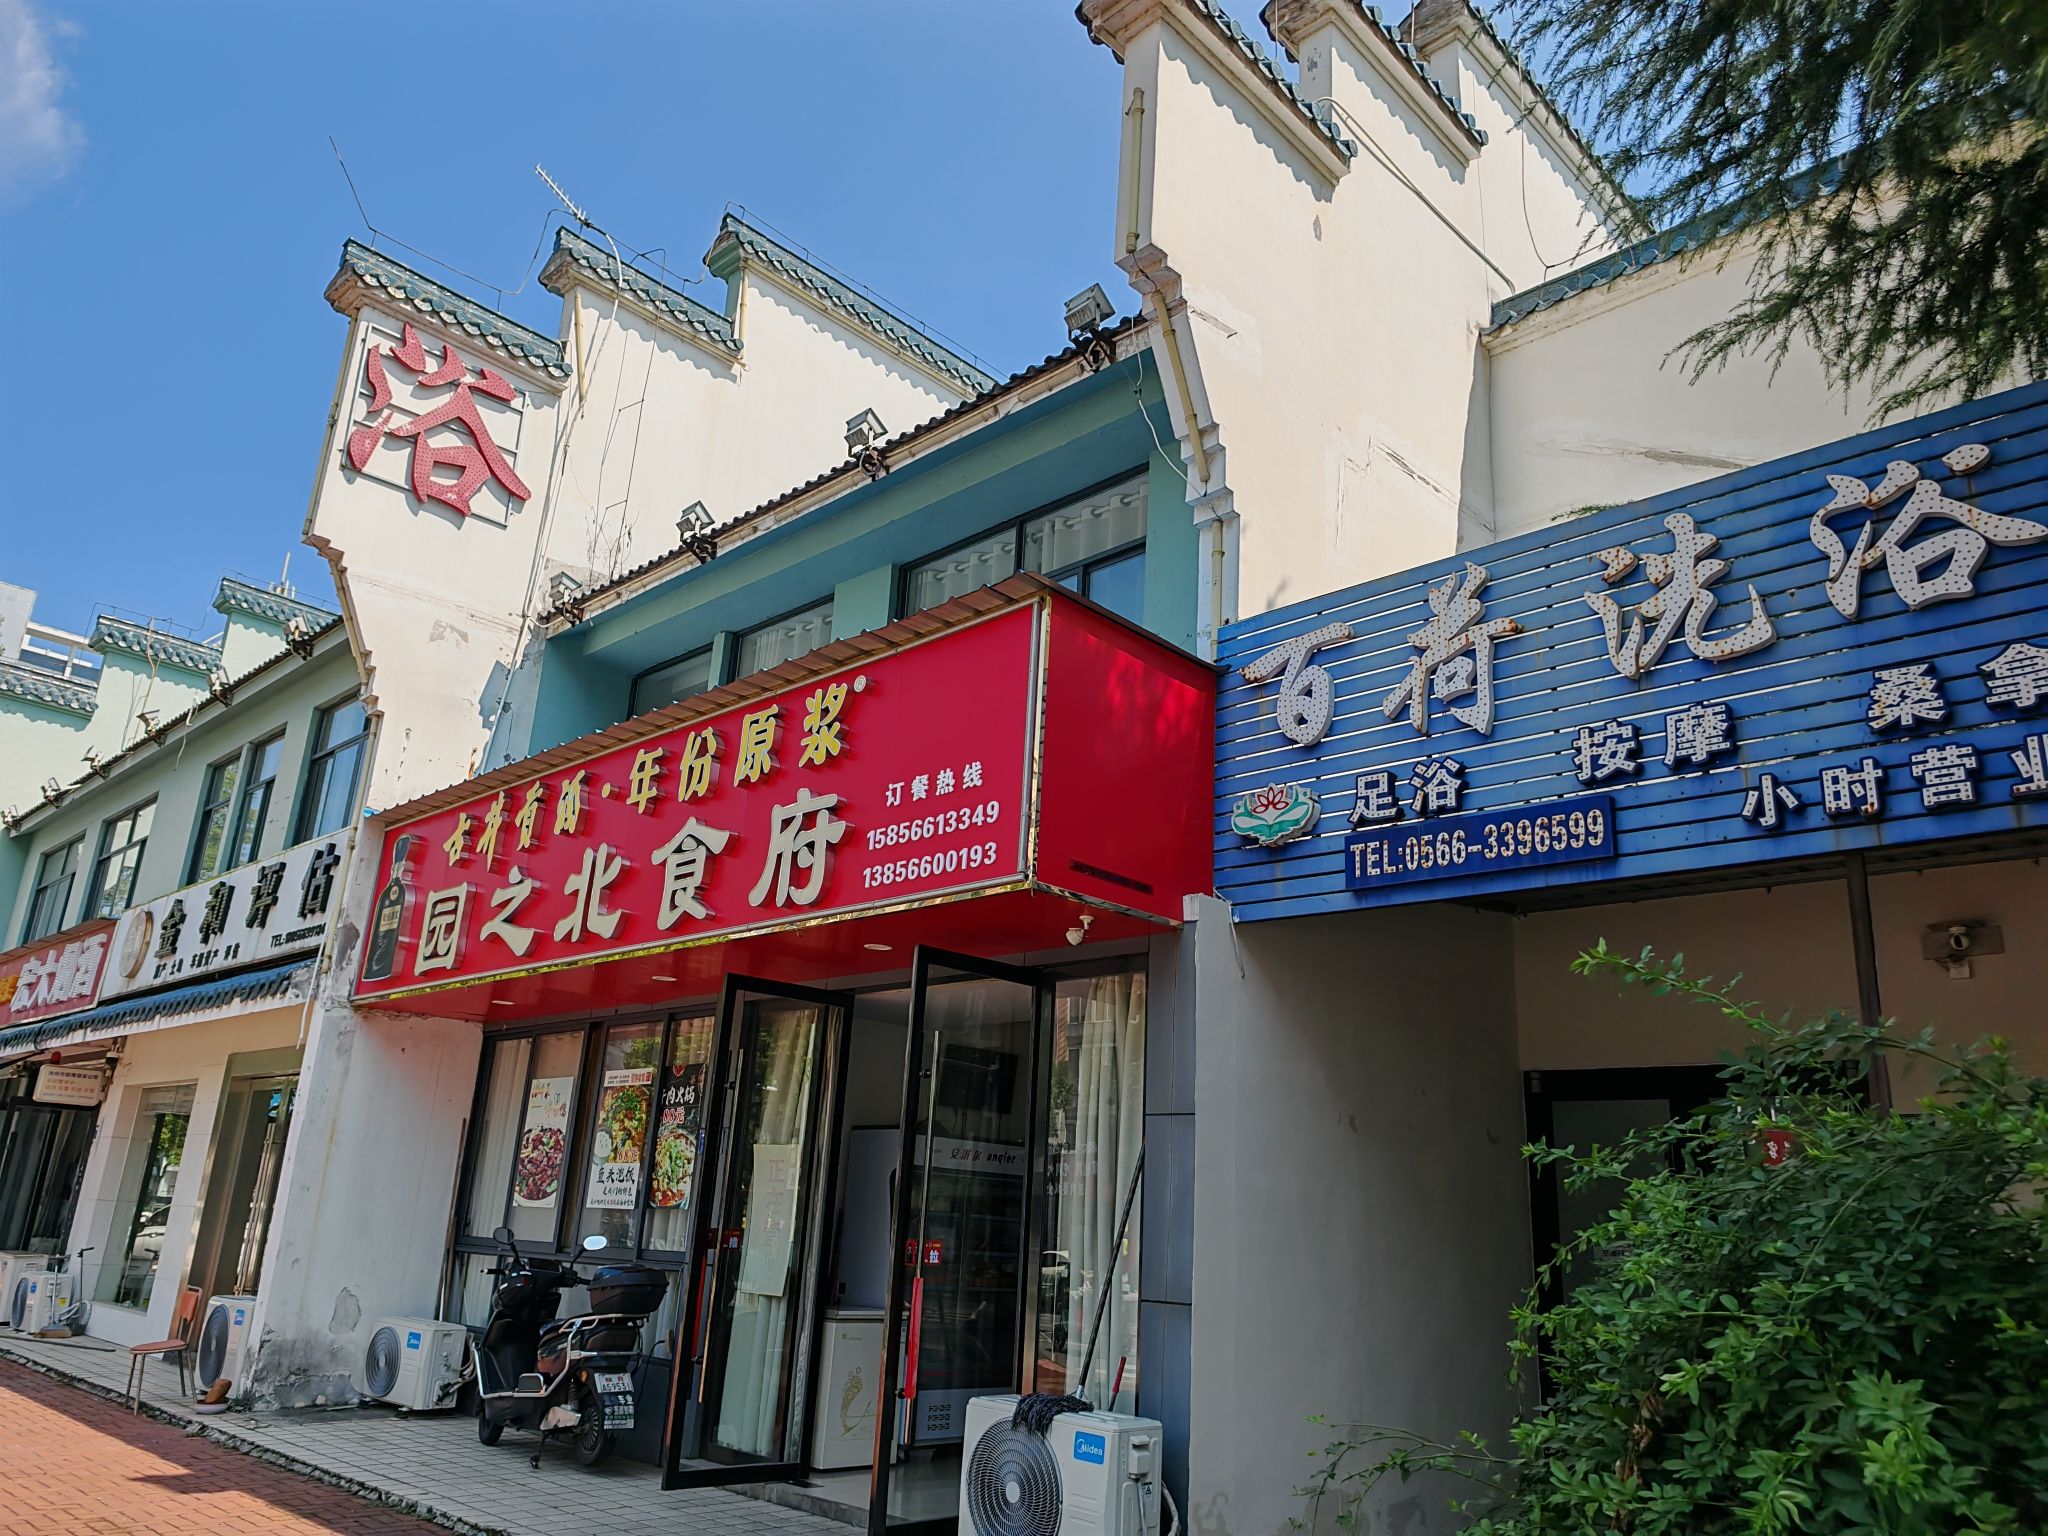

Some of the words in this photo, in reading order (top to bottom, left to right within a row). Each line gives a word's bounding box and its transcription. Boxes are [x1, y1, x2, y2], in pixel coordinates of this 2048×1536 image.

[348, 321, 532, 516] 浴
[1238, 444, 2048, 746] 百荷洗浴
[1347, 758, 1467, 825] 足浴
[1572, 701, 1734, 784] 按摩
[1866, 642, 2048, 735] 桑拿
[886, 761, 984, 807] 订餐热线
[866, 800, 1000, 851] 15856613349
[1350, 808, 1605, 879] TEL:0566-3396599
[414, 788, 846, 976] 园之北食府
[862, 842, 998, 889] 13856600193
[986, 1152, 1017, 1165] anqier
[1077, 1438, 1103, 1456] Midea
